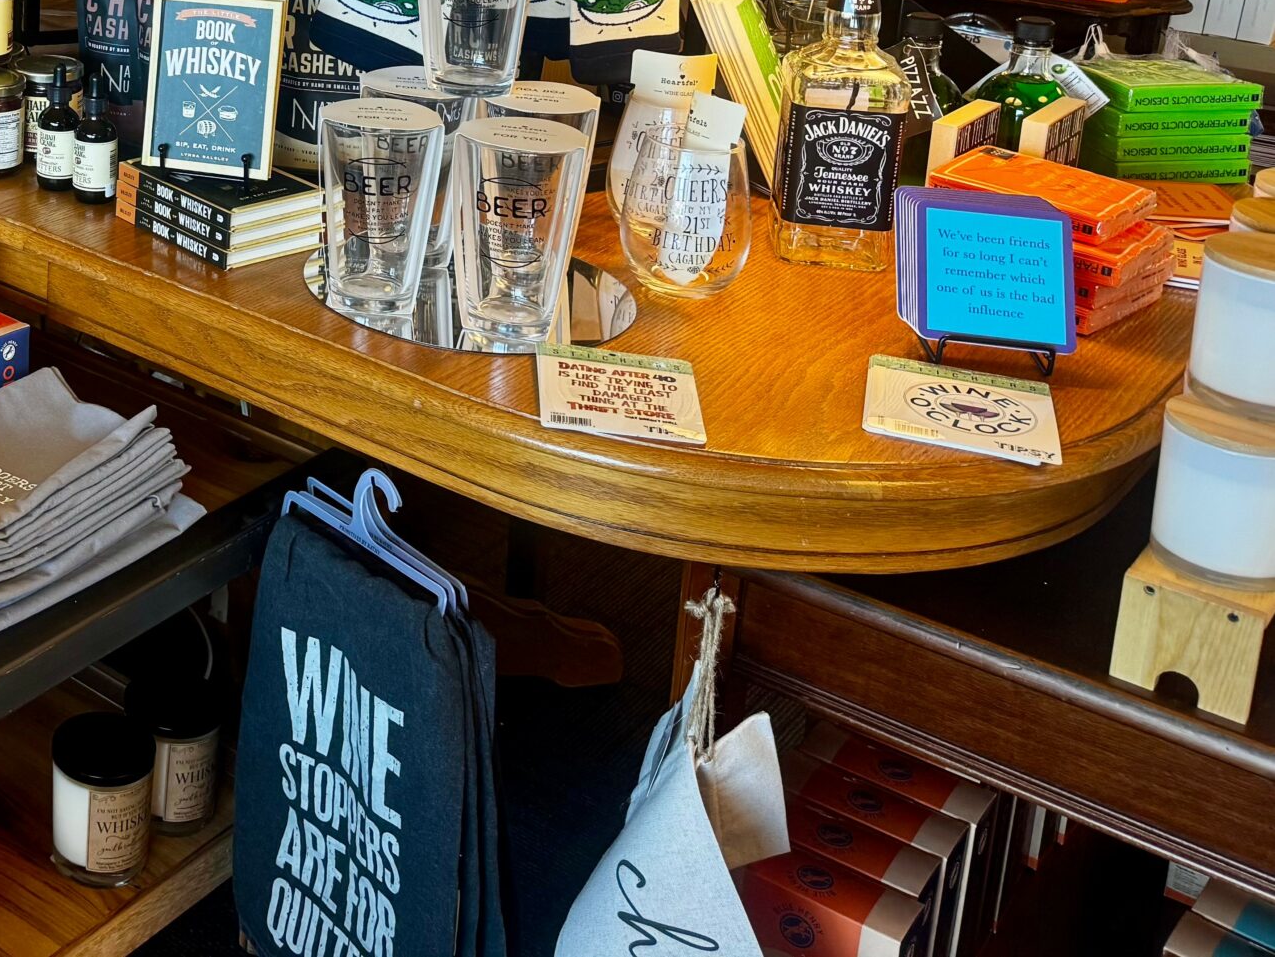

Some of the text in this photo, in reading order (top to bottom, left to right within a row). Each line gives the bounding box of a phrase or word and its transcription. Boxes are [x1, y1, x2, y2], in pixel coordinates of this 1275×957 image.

[195, 19, 237, 43] BOOK
[164, 46, 262, 86] WHISKEY
[1135, 93, 1250, 106] PAPERPRODUCTS DESIGN
[804, 116, 891, 150] JACK DANIEL'S
[192, 143, 209, 151] EAT,
[211, 145, 236, 153] DRINK
[343, 172, 412, 196] BEER
[814, 166, 869, 183] Tennessee
[664, 176, 728, 204] CHEERS
[808, 182, 871, 197] WHISKEY
[156, 184, 213, 220] BOOK WHISKEY
[476, 191, 547, 219] BEER
[699, 206, 713, 215] MY
[682, 215, 710, 235] 21ST
[651, 228, 733, 253] BIRTHDAY
[938, 228, 1051, 250] We've been friends
[943, 246, 1048, 268] for so long I can't
[945, 266, 1045, 285] remember which
[936, 284, 1055, 305] one of us is the bad
[968, 302, 1025, 320] influence
[558, 361, 676, 383] DATING AFTER 40
[558, 370, 677, 392] IS LIKE TRYING TO
[571, 379, 672, 398] FIND THE LEAST
[593, 389, 652, 403] DAMAGED
[566, 401, 677, 420] THRIFT STORE
[579, 395, 669, 412] THING AT THE
[281, 626, 405, 830] WINE
[279, 744, 400, 894] STOPPERS
[276, 805, 397, 957] ARE FOR
